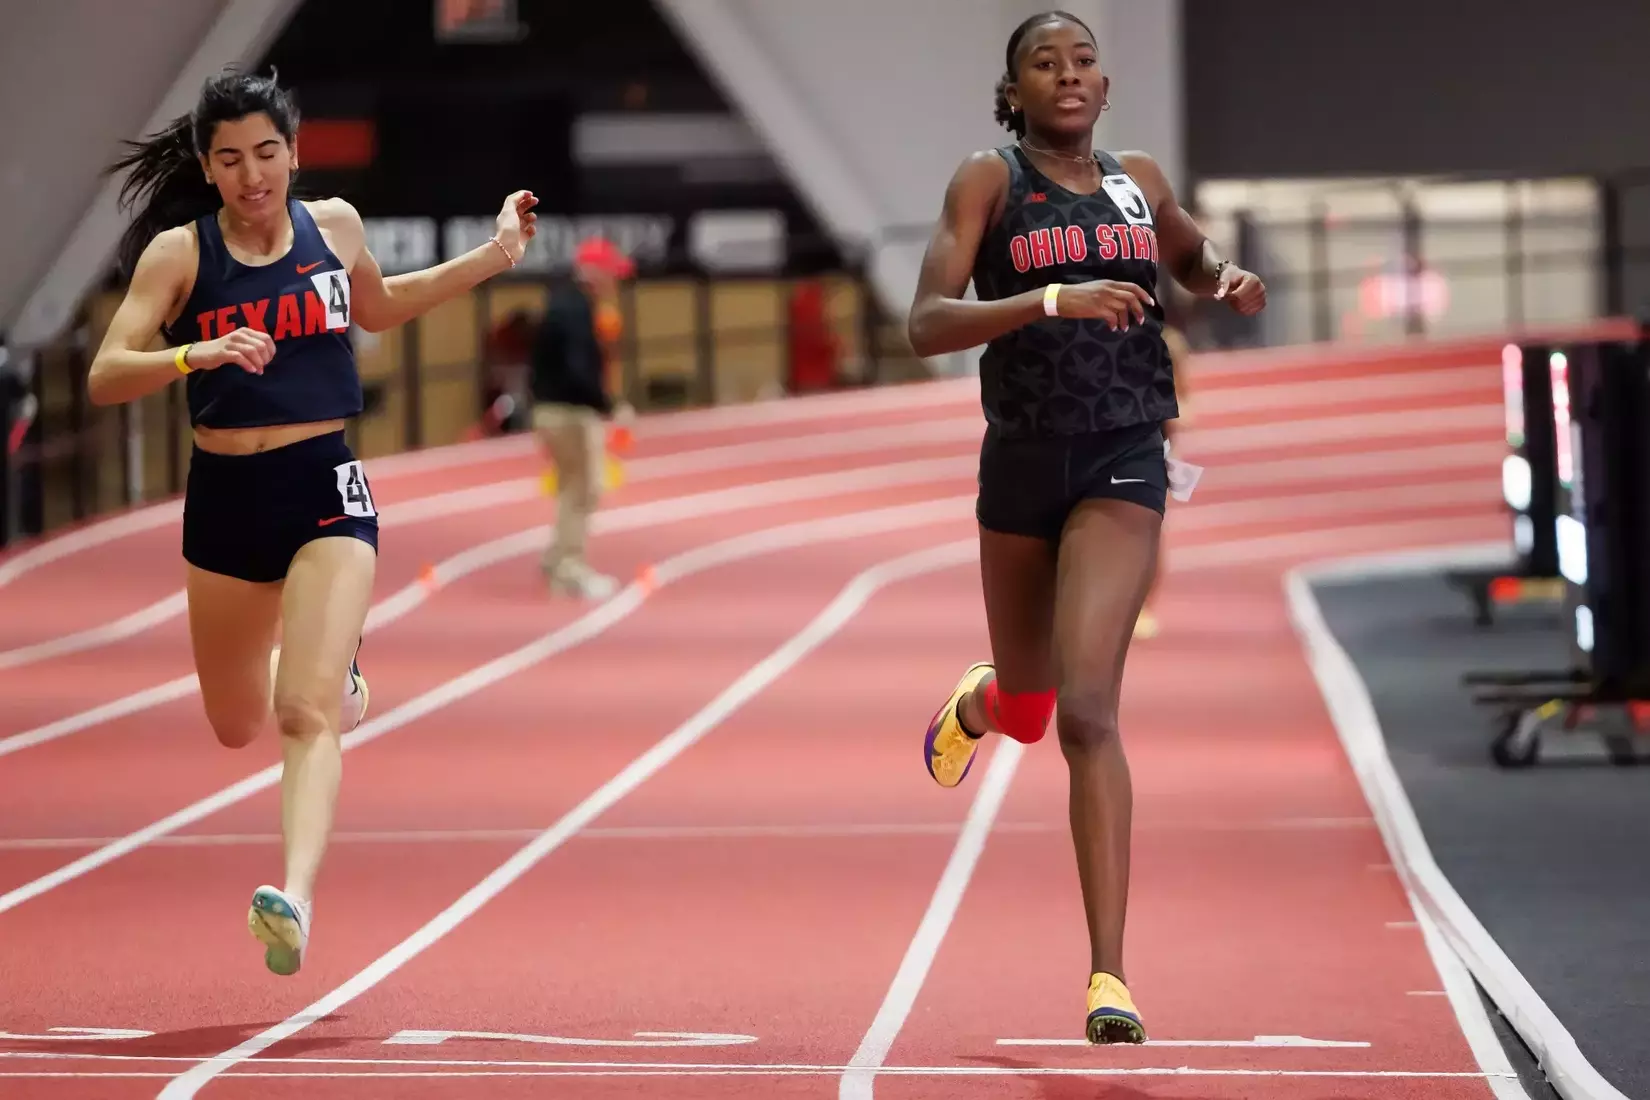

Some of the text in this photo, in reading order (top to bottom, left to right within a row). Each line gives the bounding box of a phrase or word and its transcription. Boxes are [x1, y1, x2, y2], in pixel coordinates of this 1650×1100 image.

[1010, 223, 1159, 274] OHIO STAT
[196, 290, 347, 342] TEXAN
[329, 274, 348, 323] 4
[346, 464, 369, 513] 4
